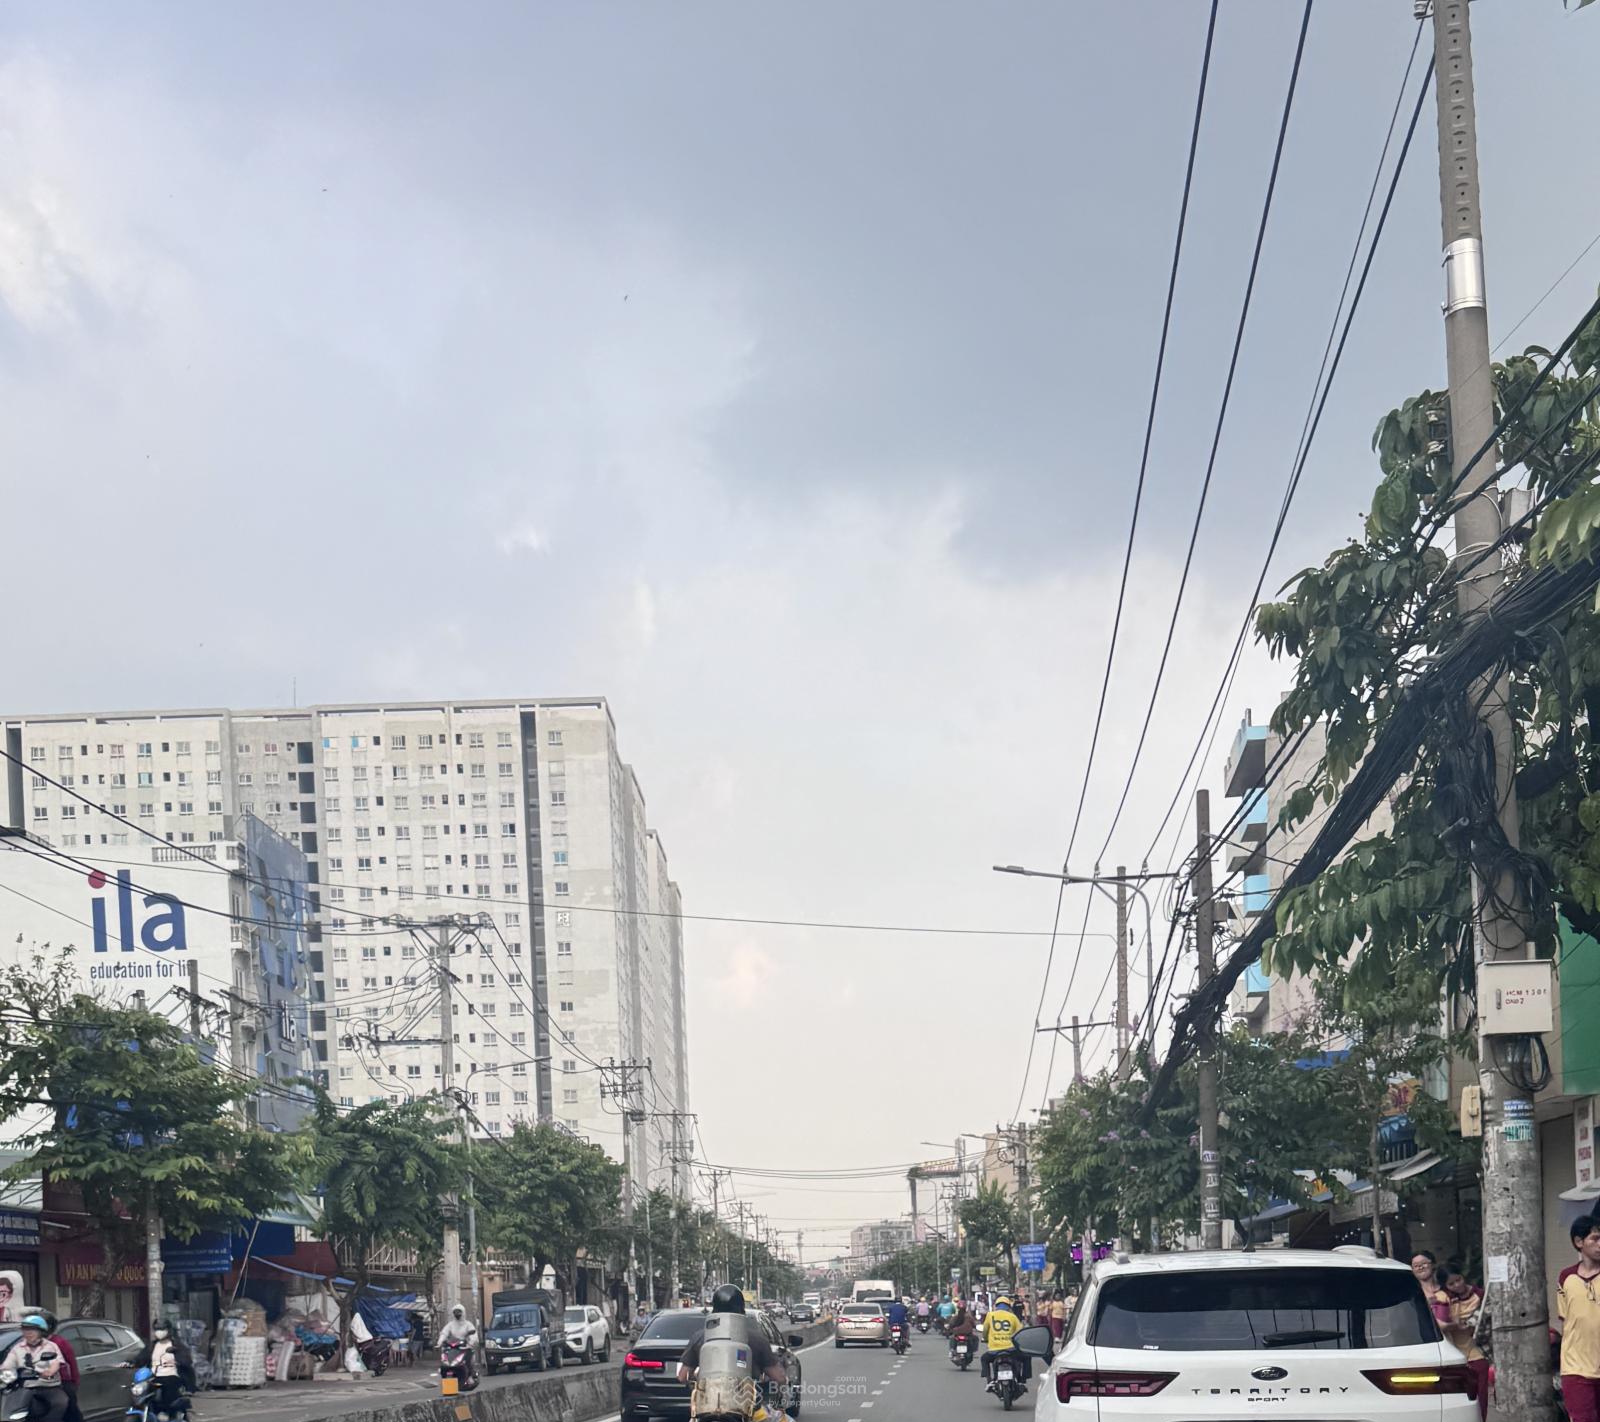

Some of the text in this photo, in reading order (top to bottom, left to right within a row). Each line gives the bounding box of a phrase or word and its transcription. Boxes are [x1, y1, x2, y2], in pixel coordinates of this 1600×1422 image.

[88, 869, 187, 953] ila
[90, 960, 193, 979] education for lif
[992, 1315, 1011, 1331] be
[1191, 1386, 1349, 1395] TERRITORY
